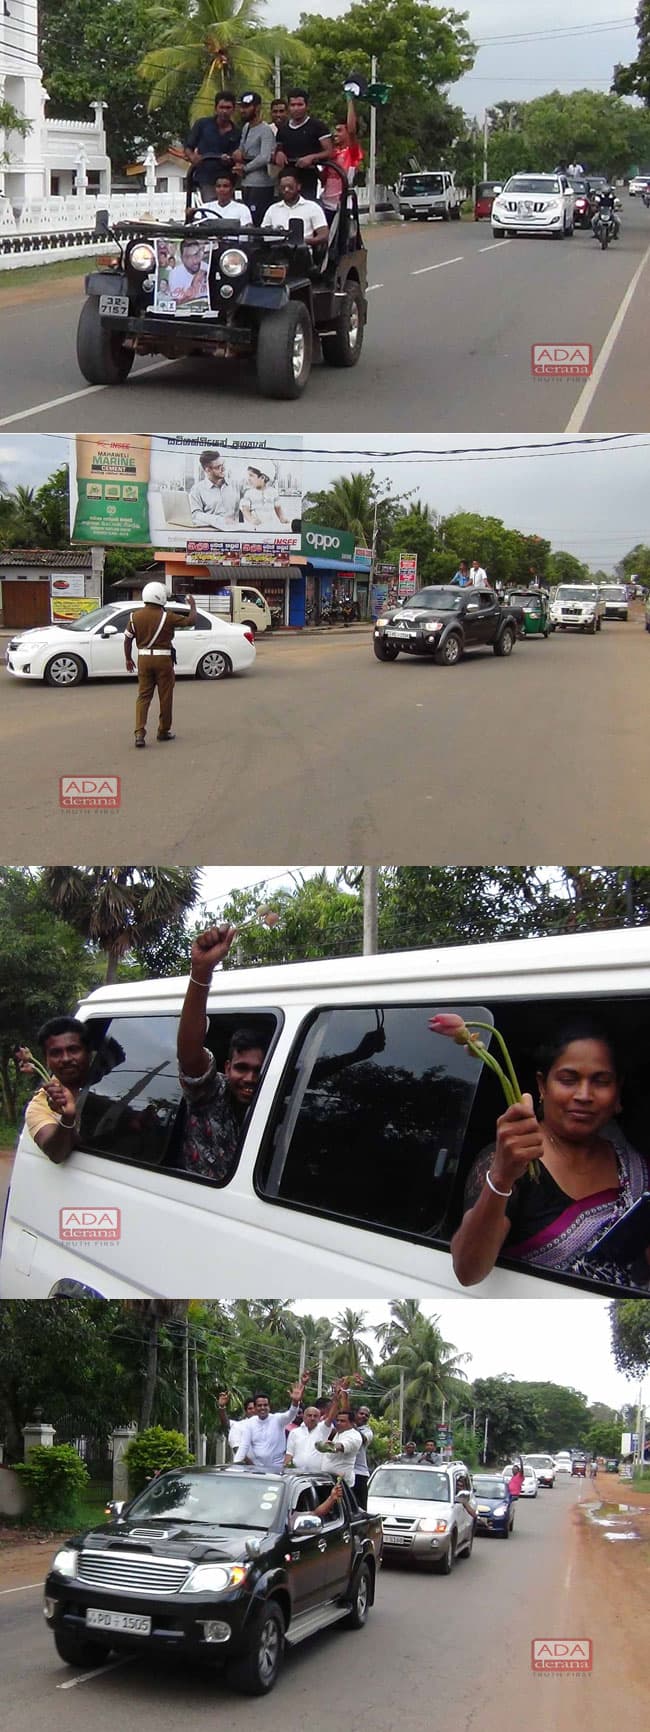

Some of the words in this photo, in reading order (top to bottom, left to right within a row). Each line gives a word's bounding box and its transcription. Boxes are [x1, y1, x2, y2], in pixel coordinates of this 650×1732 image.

[101, 305, 127, 314] 7157
[110, 441, 131, 450] INSEE
[92, 456, 136, 466] MARINE
[274, 538, 298, 546] INSEE
[123, 1617, 149, 1631] 1505
